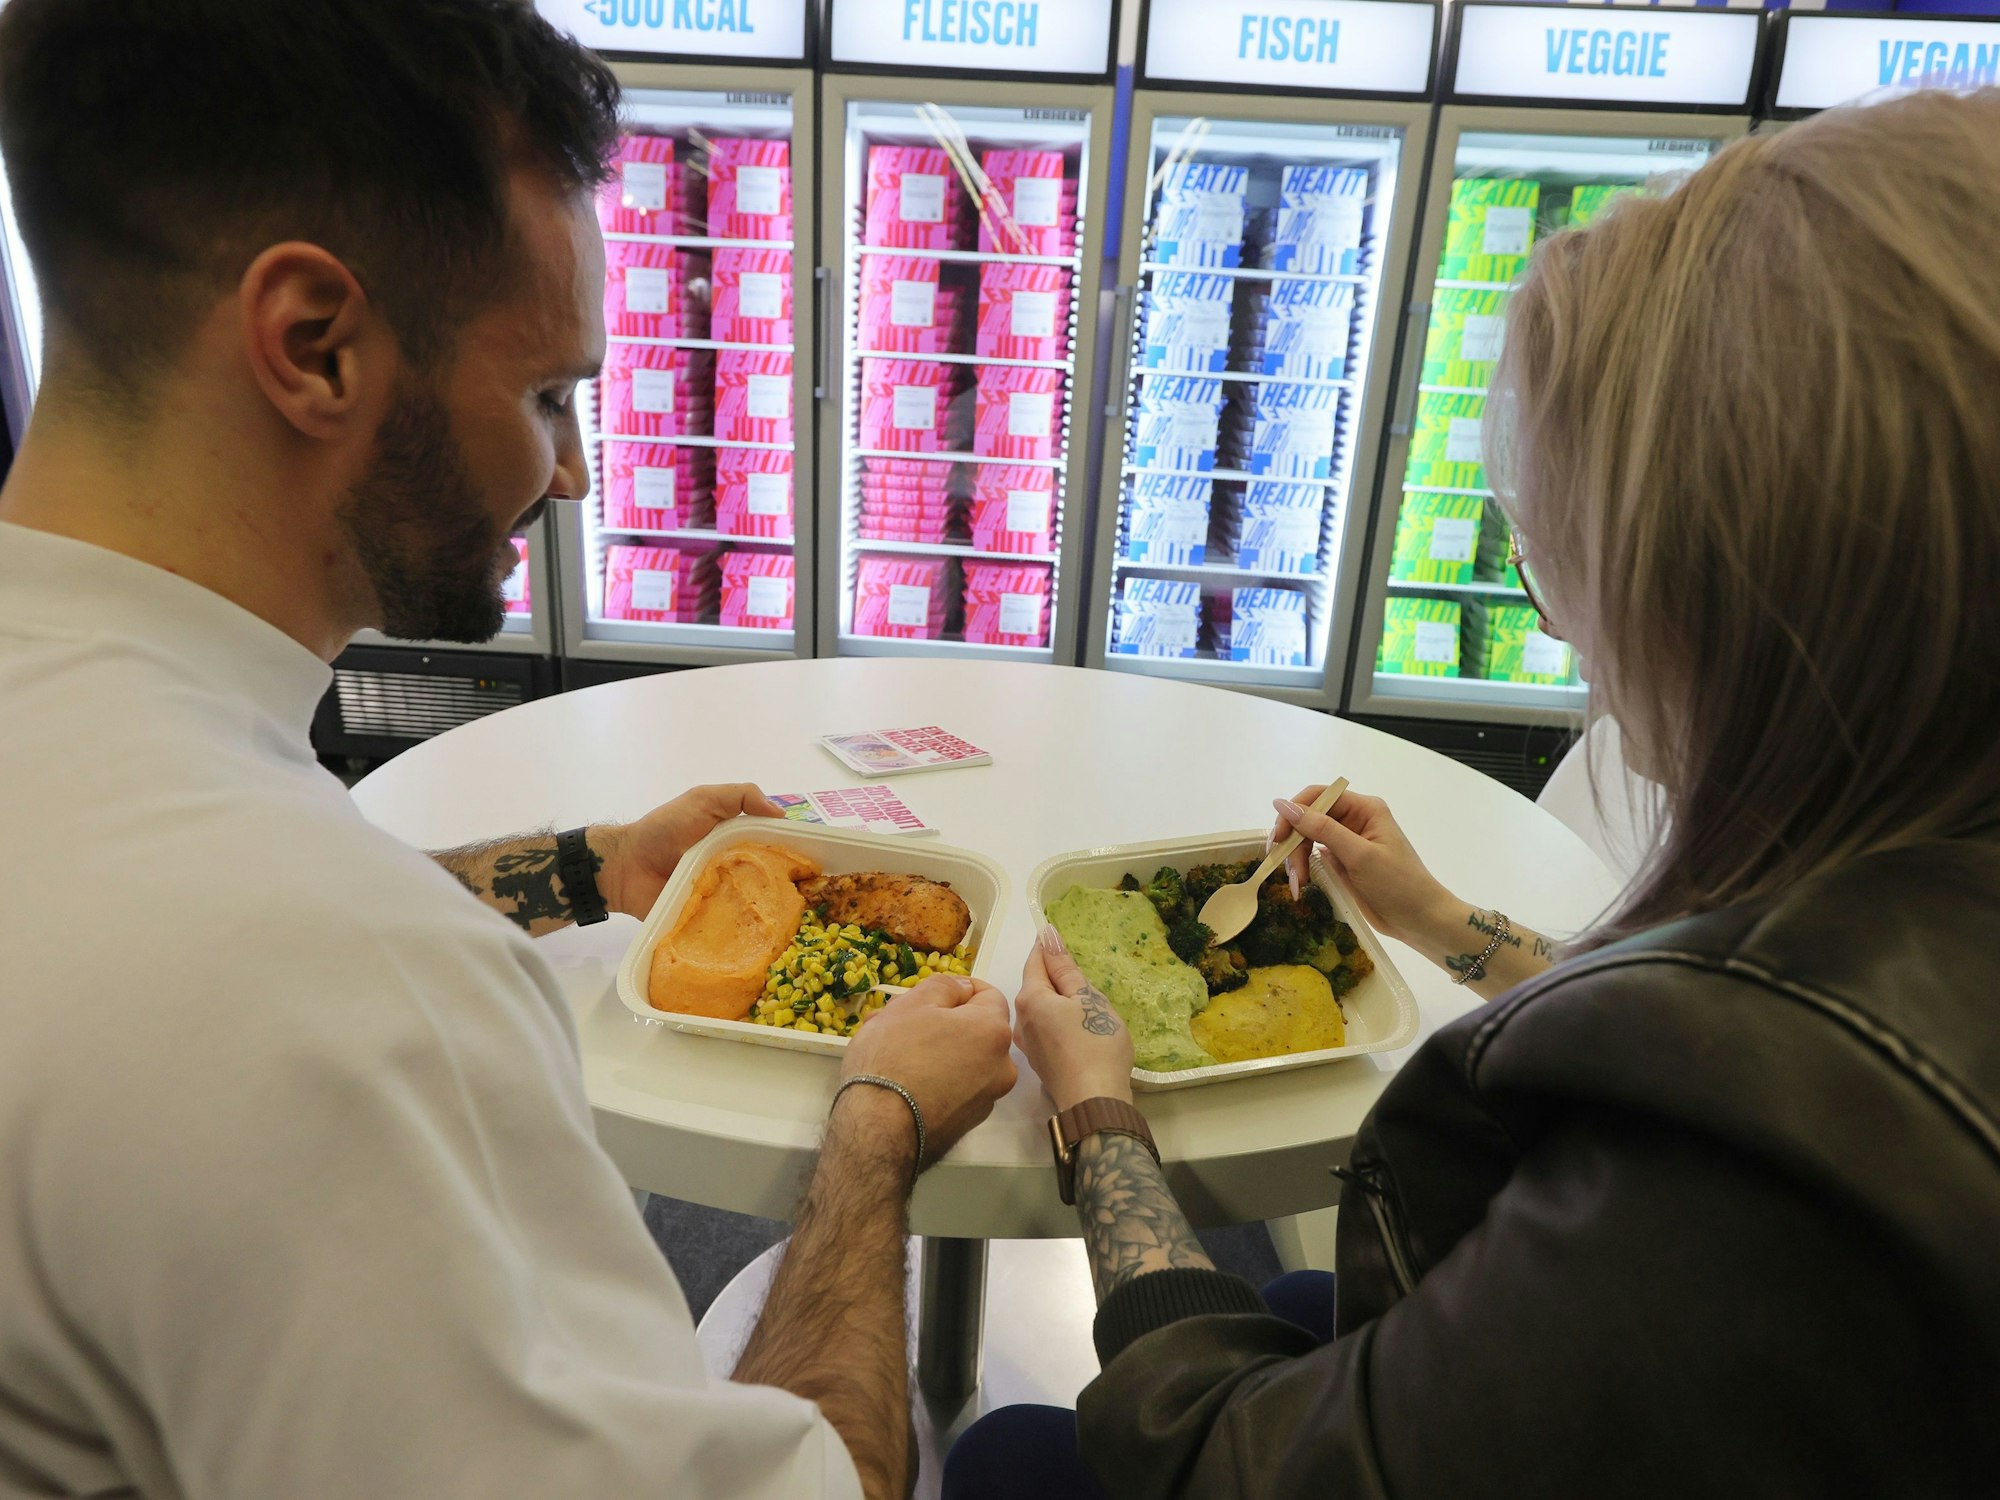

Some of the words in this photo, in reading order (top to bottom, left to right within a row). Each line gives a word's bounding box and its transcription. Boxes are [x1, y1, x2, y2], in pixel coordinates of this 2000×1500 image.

[673, 0, 754, 33] KCAL
[903, 0, 1038, 46] FLEISCH
[1239, 15, 1339, 63] FISCH
[1546, 29, 1670, 77] VEGGIE
[1879, 40, 2000, 90] VEGAN
[1285, 166, 1343, 194] HEAT
[1156, 275, 1214, 301] HEAT
[1274, 280, 1329, 307] HEAT
[1145, 377, 1203, 401] HEAT
[1262, 383, 1318, 408] HEAT
[1138, 477, 1190, 500] HEAT
[1249, 482, 1302, 507] HEAT
[1128, 580, 1181, 603] HEAT
[1235, 588, 1286, 609] HEAT
[850, 801, 888, 823] CODE
[878, 800, 925, 829] RABATT
